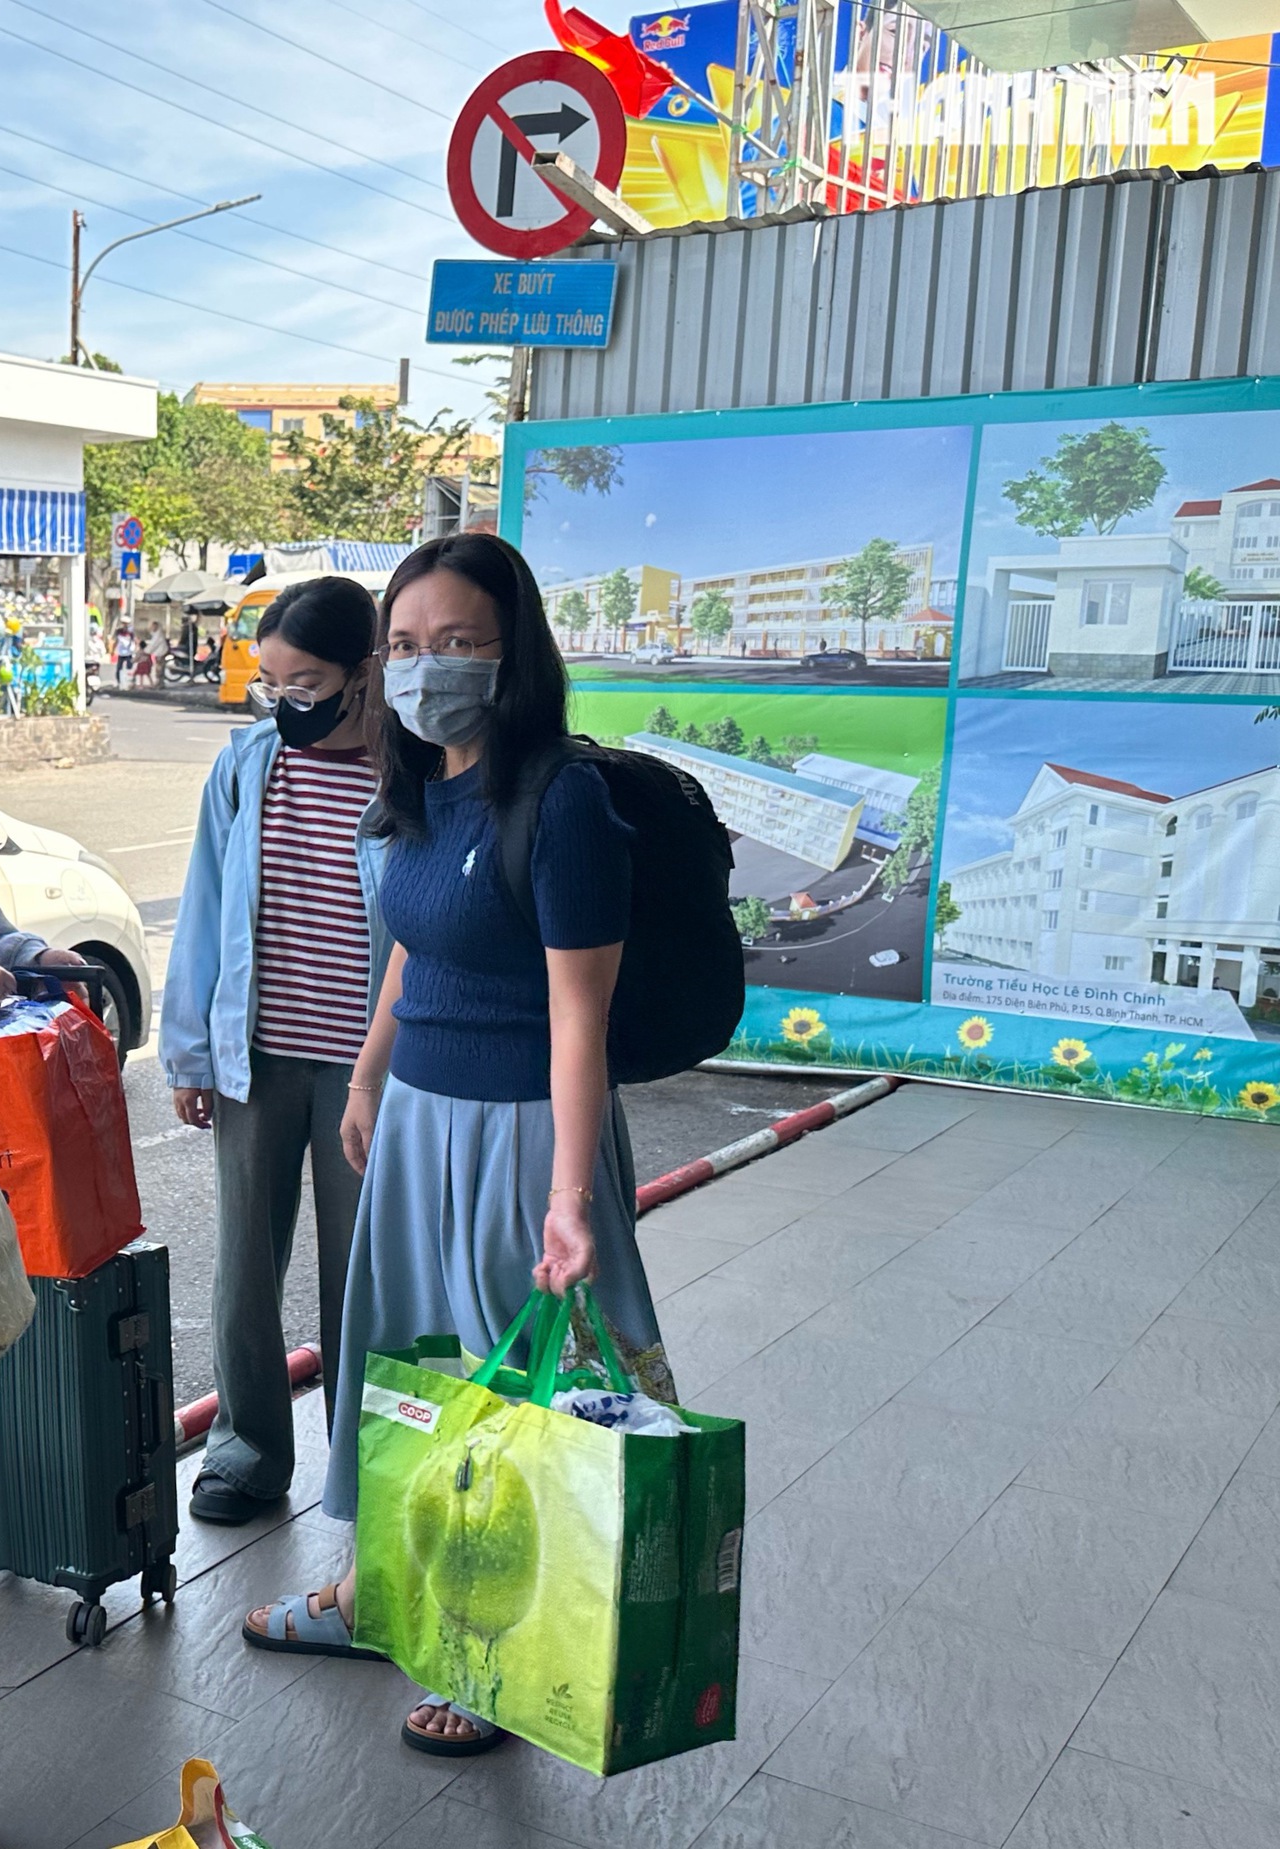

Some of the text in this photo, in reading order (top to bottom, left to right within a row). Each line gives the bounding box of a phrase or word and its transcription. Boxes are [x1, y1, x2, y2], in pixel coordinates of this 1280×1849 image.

[643, 34, 686, 52] Red Bull
[492, 268, 556, 295] XE BUÝT
[435, 308, 475, 337] ĐƯỢC
[479, 307, 520, 335] PHÉP
[556, 308, 604, 336] THÔNG
[943, 972, 1166, 1007] Trường Tiểu Học Lê Đình Chinh
[986, 995, 1003, 1006] 175
[1027, 999, 1047, 1010] Biên
[1179, 1017, 1204, 1027] HCM
[399, 1403, 431, 1421] COOP
